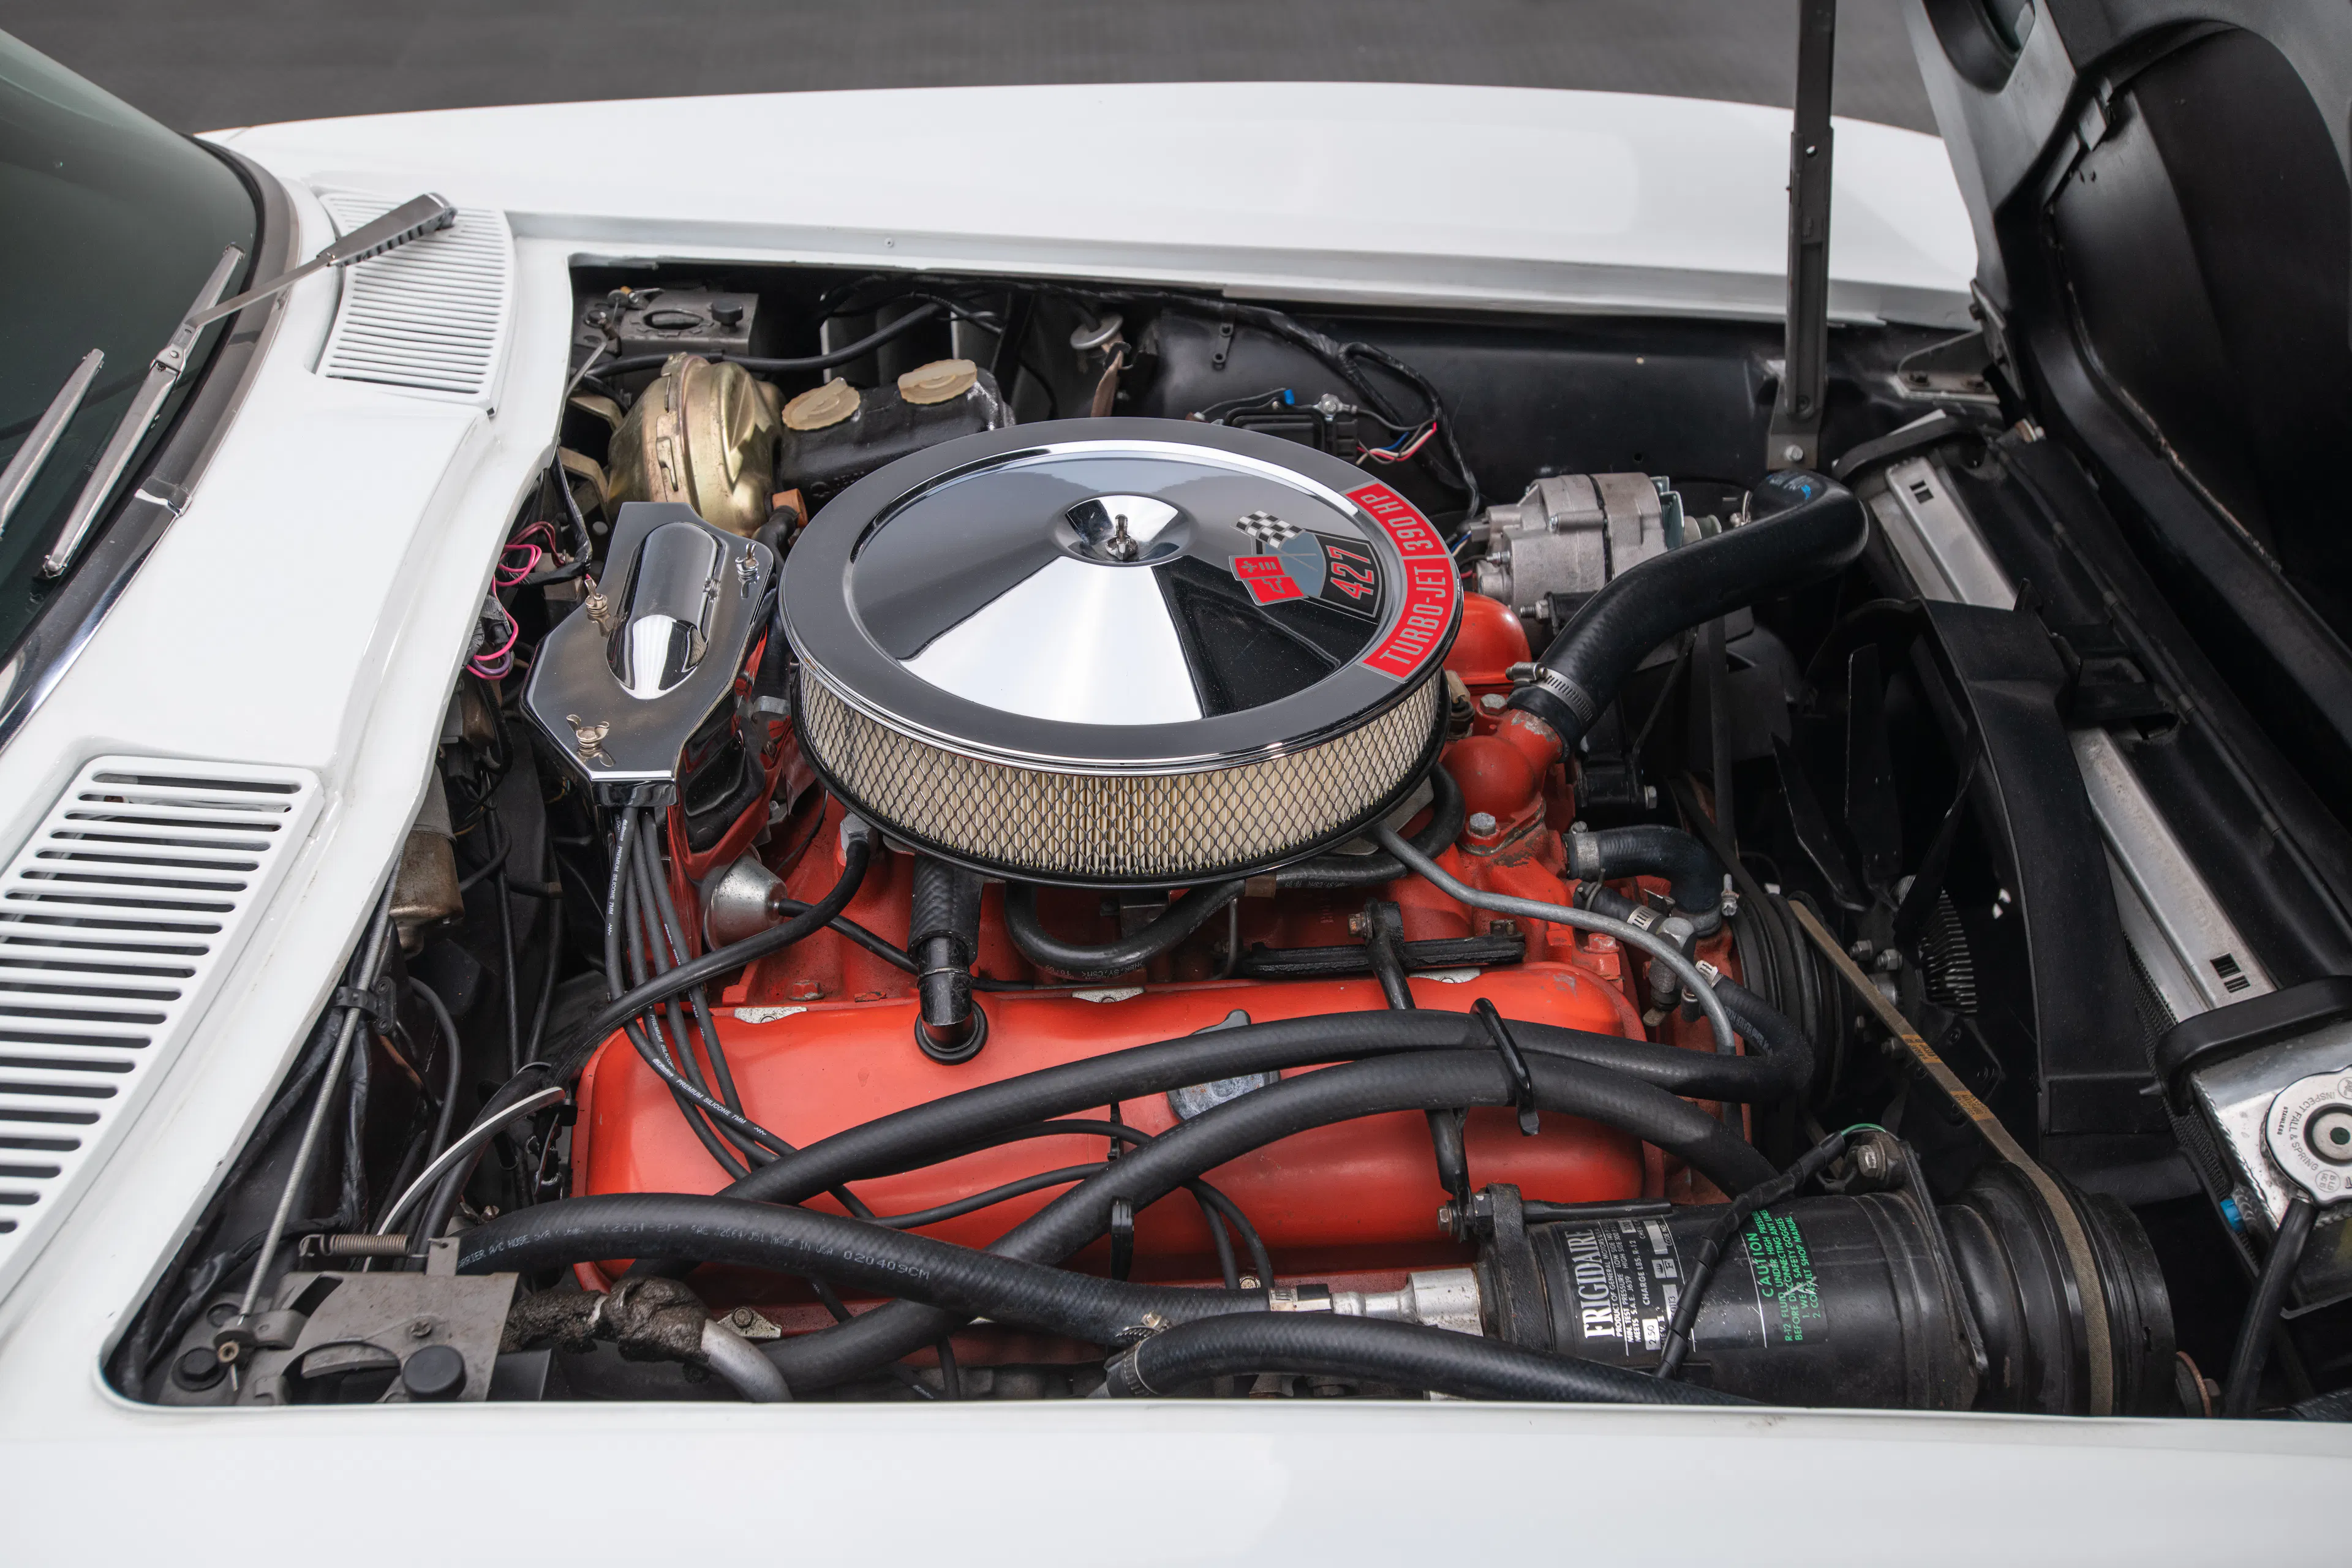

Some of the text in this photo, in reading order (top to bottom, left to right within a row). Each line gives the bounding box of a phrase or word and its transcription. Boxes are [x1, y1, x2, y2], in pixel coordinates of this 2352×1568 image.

[1327, 545, 1375, 600] 427
[1360, 494, 1447, 665] TURBO-JET 390 HP
[614, 846, 622, 872] PREMIUM
[649, 1014, 676, 1070] PREMIUM SILICON
[676, 1079, 704, 1099] PREMIUM
[703, 1098, 731, 1116] SILICONE
[731, 1114, 747, 1125] 7MM
[2299, 1091, 2335, 1112] INSPECT
[2277, 1106, 2288, 1136] STAINLESS
[2289, 1111, 2302, 1132] FALL
[2292, 1142, 2319, 1171] SPRING
[1759, 1209, 1773, 1222] LINES
[1662, 1233, 1673, 1246] CODE
[1766, 1222, 1779, 1235] ANY
[1774, 1216, 1793, 1248] GOGGLES
[1784, 1215, 1803, 1243] MANUAL
[488, 1242, 504, 1256] A/C
[507, 1234, 531, 1249] HOSE
[799, 1240, 812, 1252] IN
[816, 1244, 834, 1256] USA
[1597, 1237, 1609, 1259] MOTORS
[1609, 1242, 1618, 1253] SIDE
[1616, 1242, 1624, 1253] SIDE
[1762, 1236, 1775, 1255] HIGH
[1796, 1245, 1810, 1266] SHOP
[843, 1251, 930, 1281] 020409CM
[1613, 1254, 1621, 1268] LOW
[1619, 1254, 1629, 1269] HIGH
[1629, 1240, 1651, 1306] CHARGE LBS. R-12
[1746, 1233, 1774, 1297] CAUTION
[1769, 1259, 1784, 1287] UNDER
[1787, 1250, 1803, 1278] SAFETY
[1564, 1229, 1615, 1338] FRIGIDAIRE
[1605, 1261, 1616, 1290] GENERAL
[1624, 1275, 1635, 1292] J639
[1610, 1292, 1618, 1302] OF
[1617, 1273, 1629, 1305] PRESSURE
[1623, 1308, 1632, 1324] TEST
[1777, 1292, 1789, 1318] FLUID
[1812, 1310, 1821, 1319] 2.
[1611, 1303, 1623, 1337] PRODUCT
[1632, 1318, 1642, 1343] MEETS
[1783, 1323, 1793, 1341] R-12
[1790, 1305, 1803, 1341] BEFORE
[1626, 1325, 1635, 1343] MIN.
